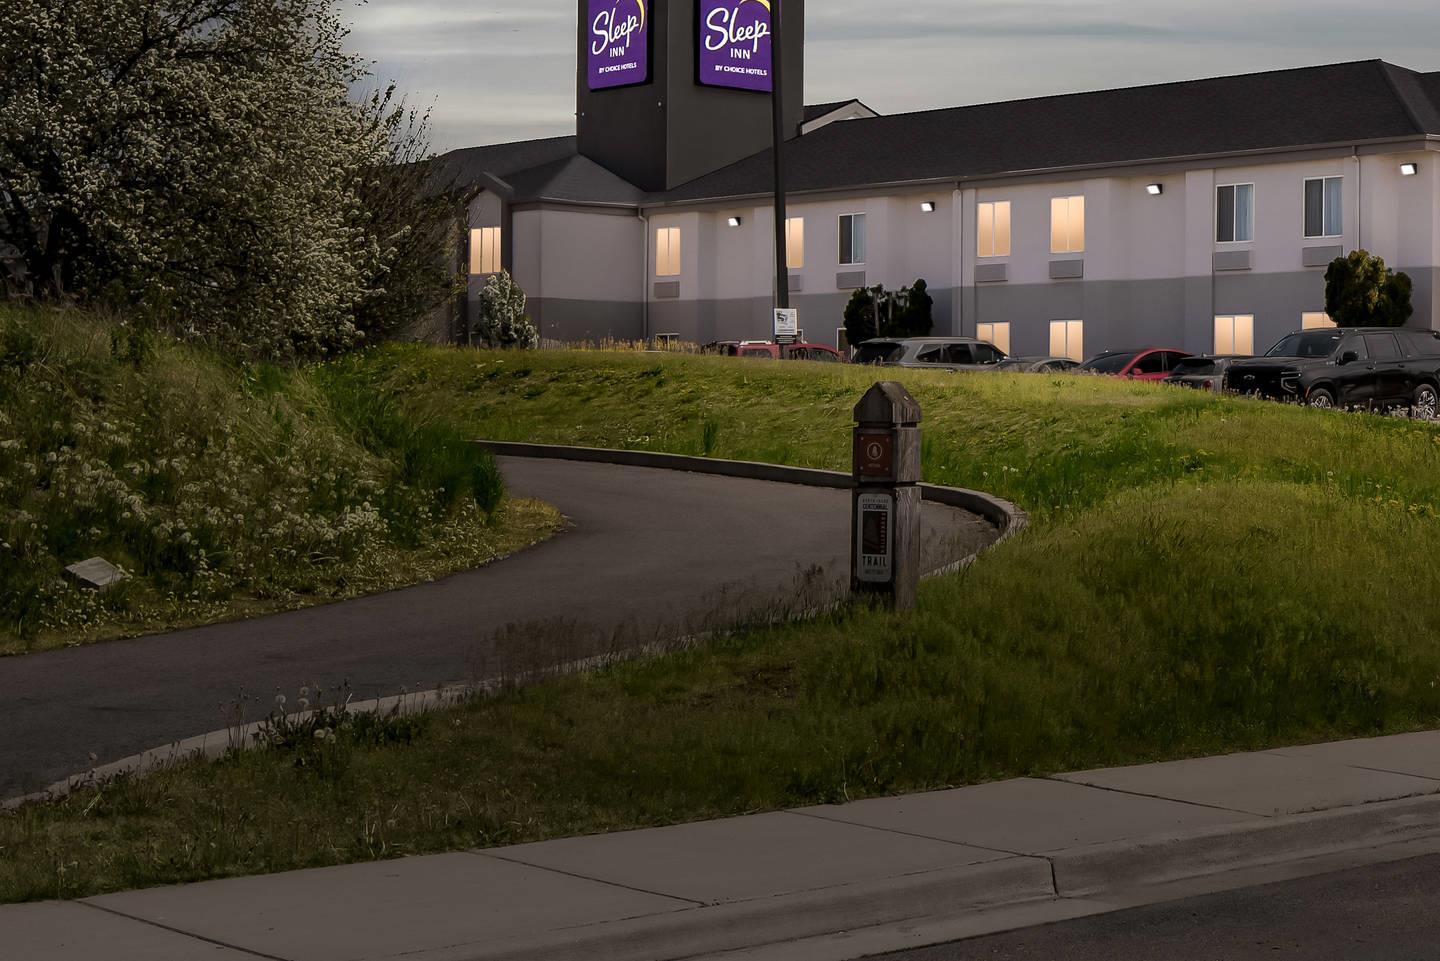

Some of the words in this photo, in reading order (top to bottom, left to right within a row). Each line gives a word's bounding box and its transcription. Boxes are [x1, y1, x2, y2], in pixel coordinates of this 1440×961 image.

[592, 7, 639, 55] Sleep
[705, 7, 771, 53] Sleep
[609, 46, 625, 58] INN
[730, 47, 751, 60] INN
[604, 64, 621, 73] CHOICE
[620, 62, 637, 70] HOTELS
[723, 65, 745, 74] CHOICE
[745, 68, 768, 76] HOTELS
[862, 556, 886, 567] TRAIL
